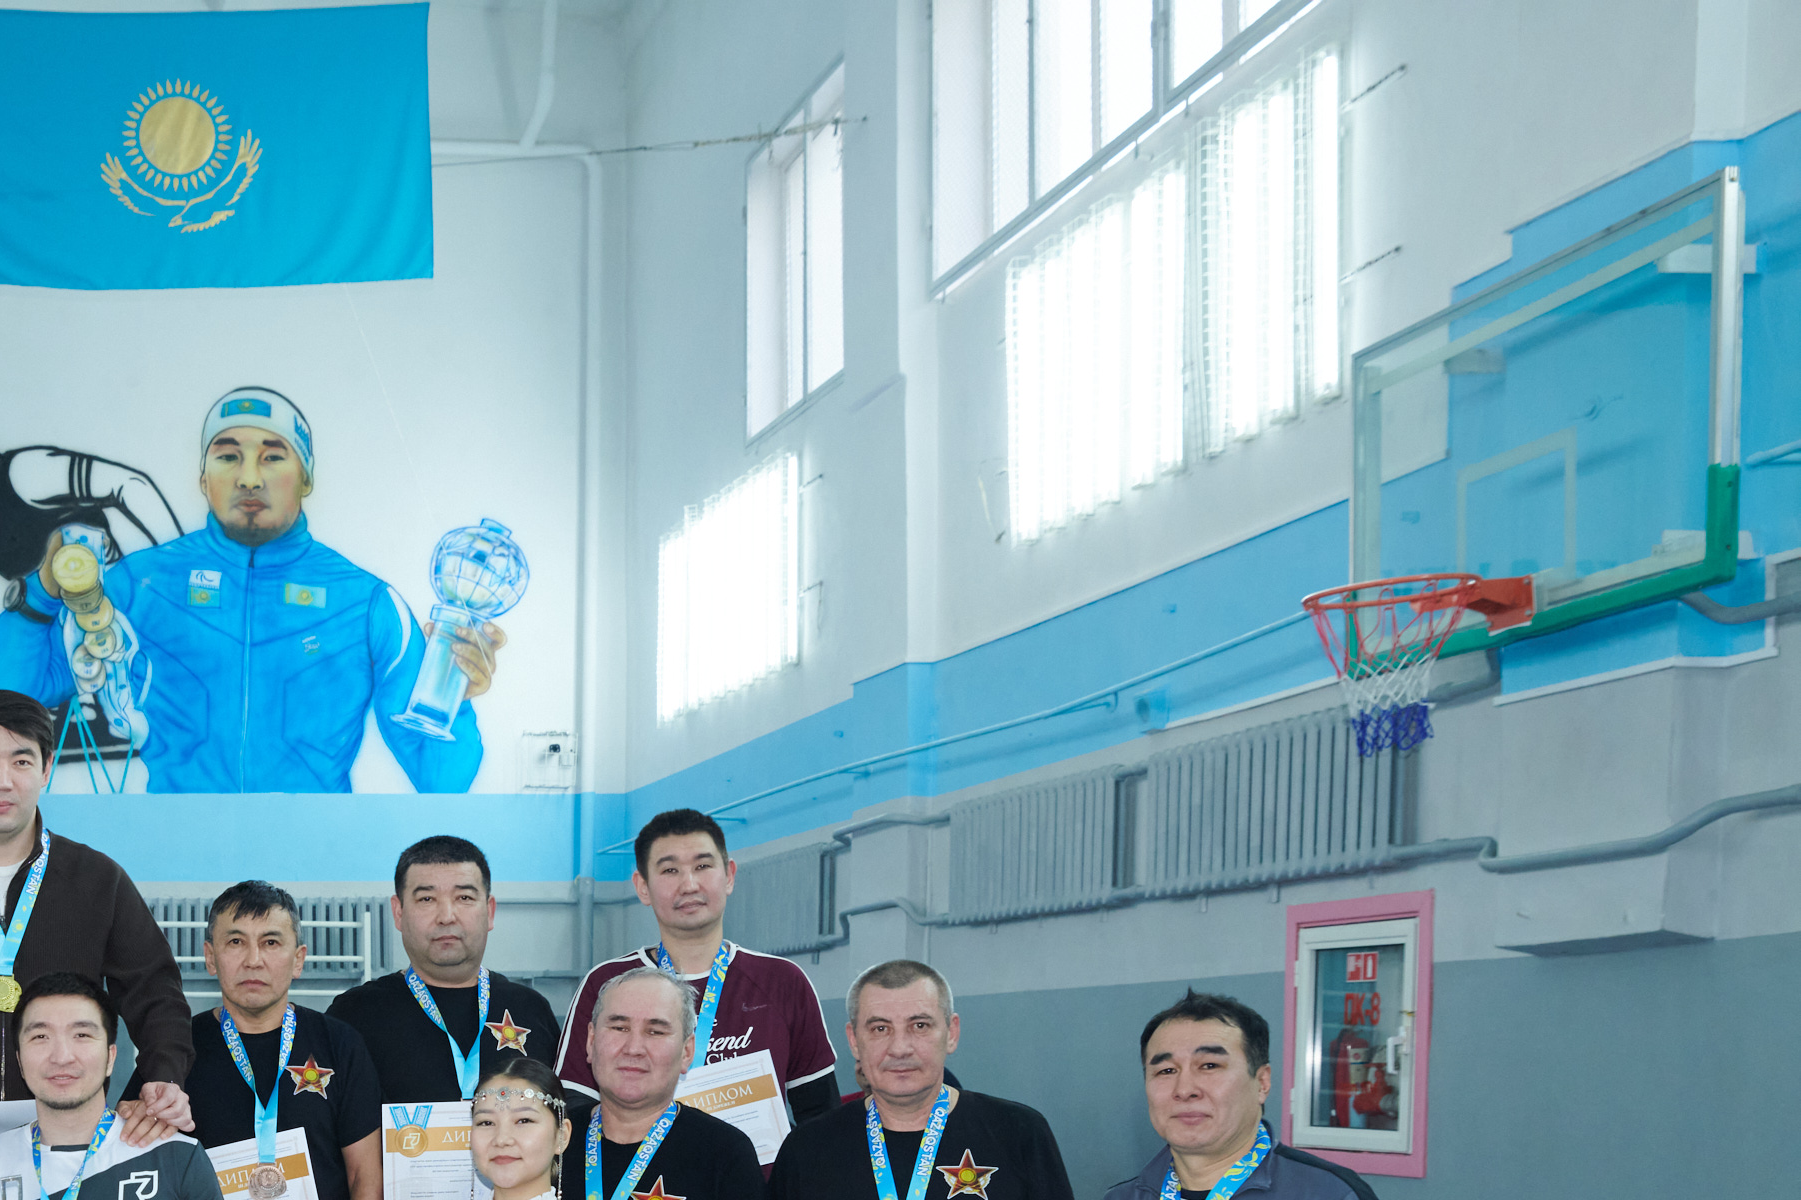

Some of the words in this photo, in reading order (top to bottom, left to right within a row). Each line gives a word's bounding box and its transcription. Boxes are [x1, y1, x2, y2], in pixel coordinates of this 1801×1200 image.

[223, 1020, 253, 1082] QAZAQSTAN
[627, 1119, 669, 1181] QAZAQSTAN
[917, 1107, 945, 1176] QAZAQSTAN
